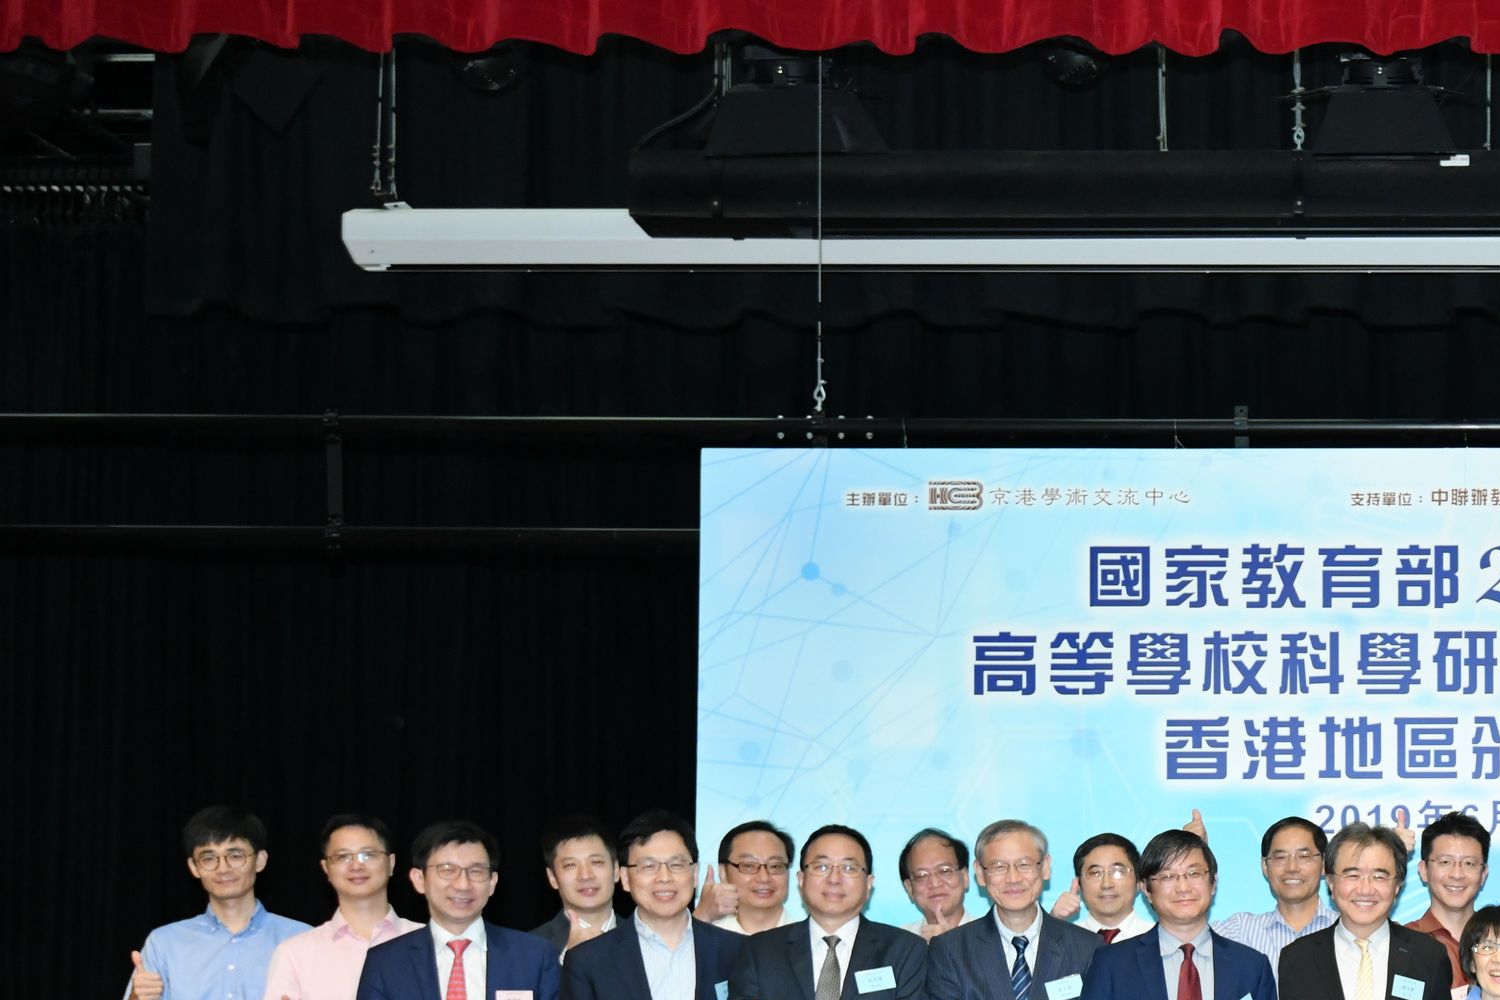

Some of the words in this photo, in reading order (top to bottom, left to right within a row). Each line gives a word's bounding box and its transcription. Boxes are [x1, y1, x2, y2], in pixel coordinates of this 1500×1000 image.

[988, 487, 1193, 507] 京港學術交流中心
